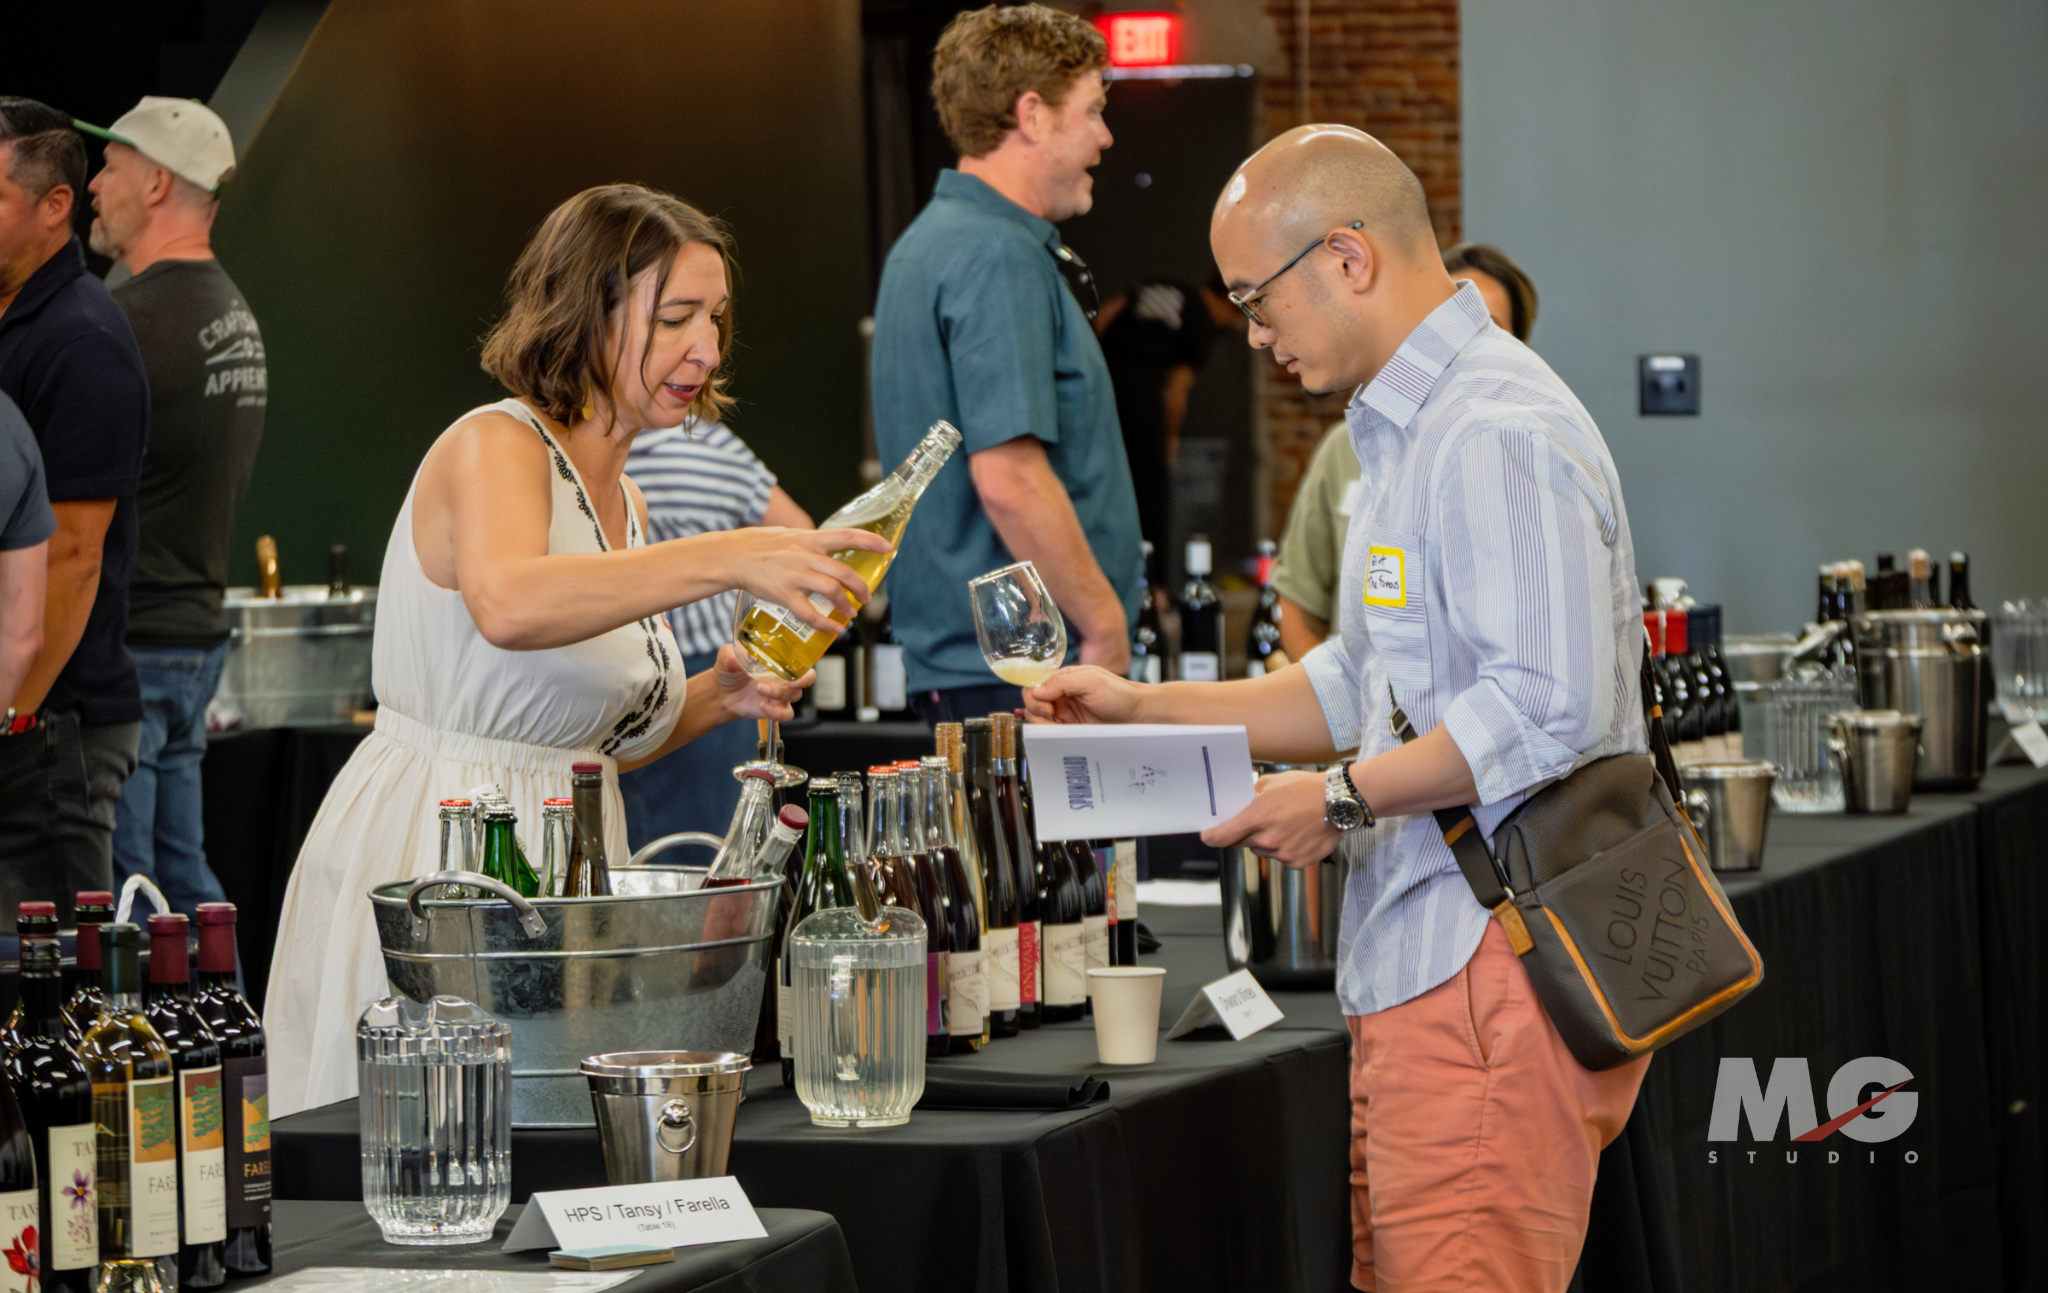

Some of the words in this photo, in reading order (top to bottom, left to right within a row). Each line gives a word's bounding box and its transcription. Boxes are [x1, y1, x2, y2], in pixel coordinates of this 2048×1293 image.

[1114, 17, 1168, 62] EXIT
[1063, 756, 1094, 810] SPRINGBOARD
[1600, 868, 1648, 965] LOUIS
[1637, 856, 1687, 1000] VUITTON
[1686, 914, 1710, 976] PARIS
[1023, 927, 1033, 997] ONWARD
[564, 1206, 603, 1223] HPS
[606, 1205, 612, 1220] /
[613, 1203, 662, 1219] Tansy
[665, 1200, 672, 1214] /
[674, 1196, 731, 1213] Farella
